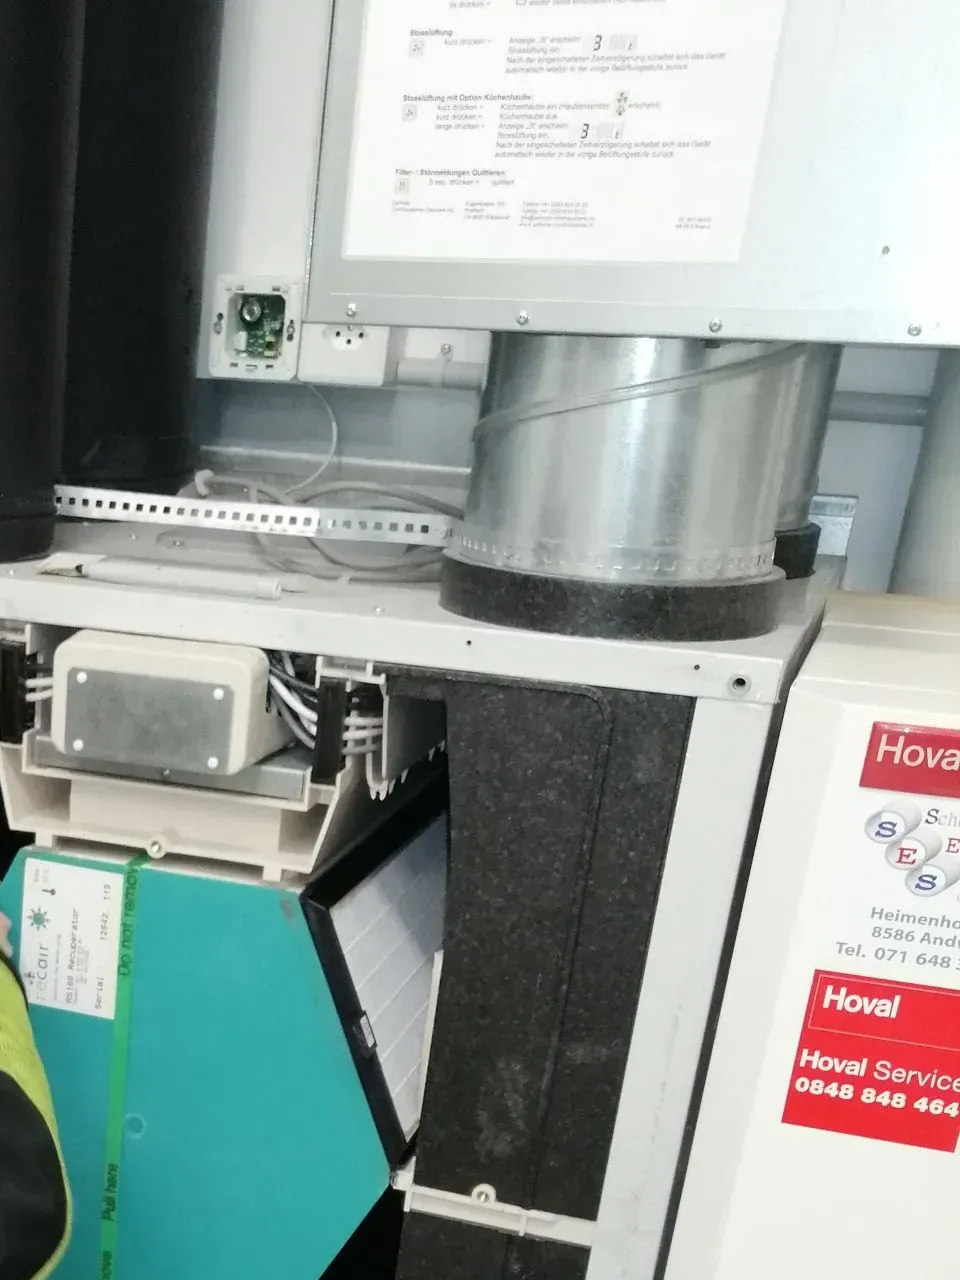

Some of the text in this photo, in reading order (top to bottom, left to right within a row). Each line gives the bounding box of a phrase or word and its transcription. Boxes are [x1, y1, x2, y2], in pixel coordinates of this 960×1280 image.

[593, 34, 603, 51] 3
[402, 94, 445, 103] Stosslüftung
[459, 94, 483, 102] Option
[500, 103, 545, 111] Küchenhaube
[580, 123, 590, 139] 3
[494, 150, 533, 159] automatisch
[534, 150, 556, 159] wieder
[495, 141, 513, 149] Nach
[514, 141, 526, 149] der
[68, 906, 80, 970] Recuperator
[120, 922, 134, 949] not
[871, 926, 915, 942] 8586
[117, 953, 133, 977] Do
[836, 941, 952, 969] Tel. 071 648
[94, 976, 105, 1009] Serial
[822, 984, 901, 1019] Hoval
[799, 1048, 960, 1093] Hoval Service
[795, 1076, 960, 1118] 0848 848 464
[102, 1162, 119, 1222] Pull here
